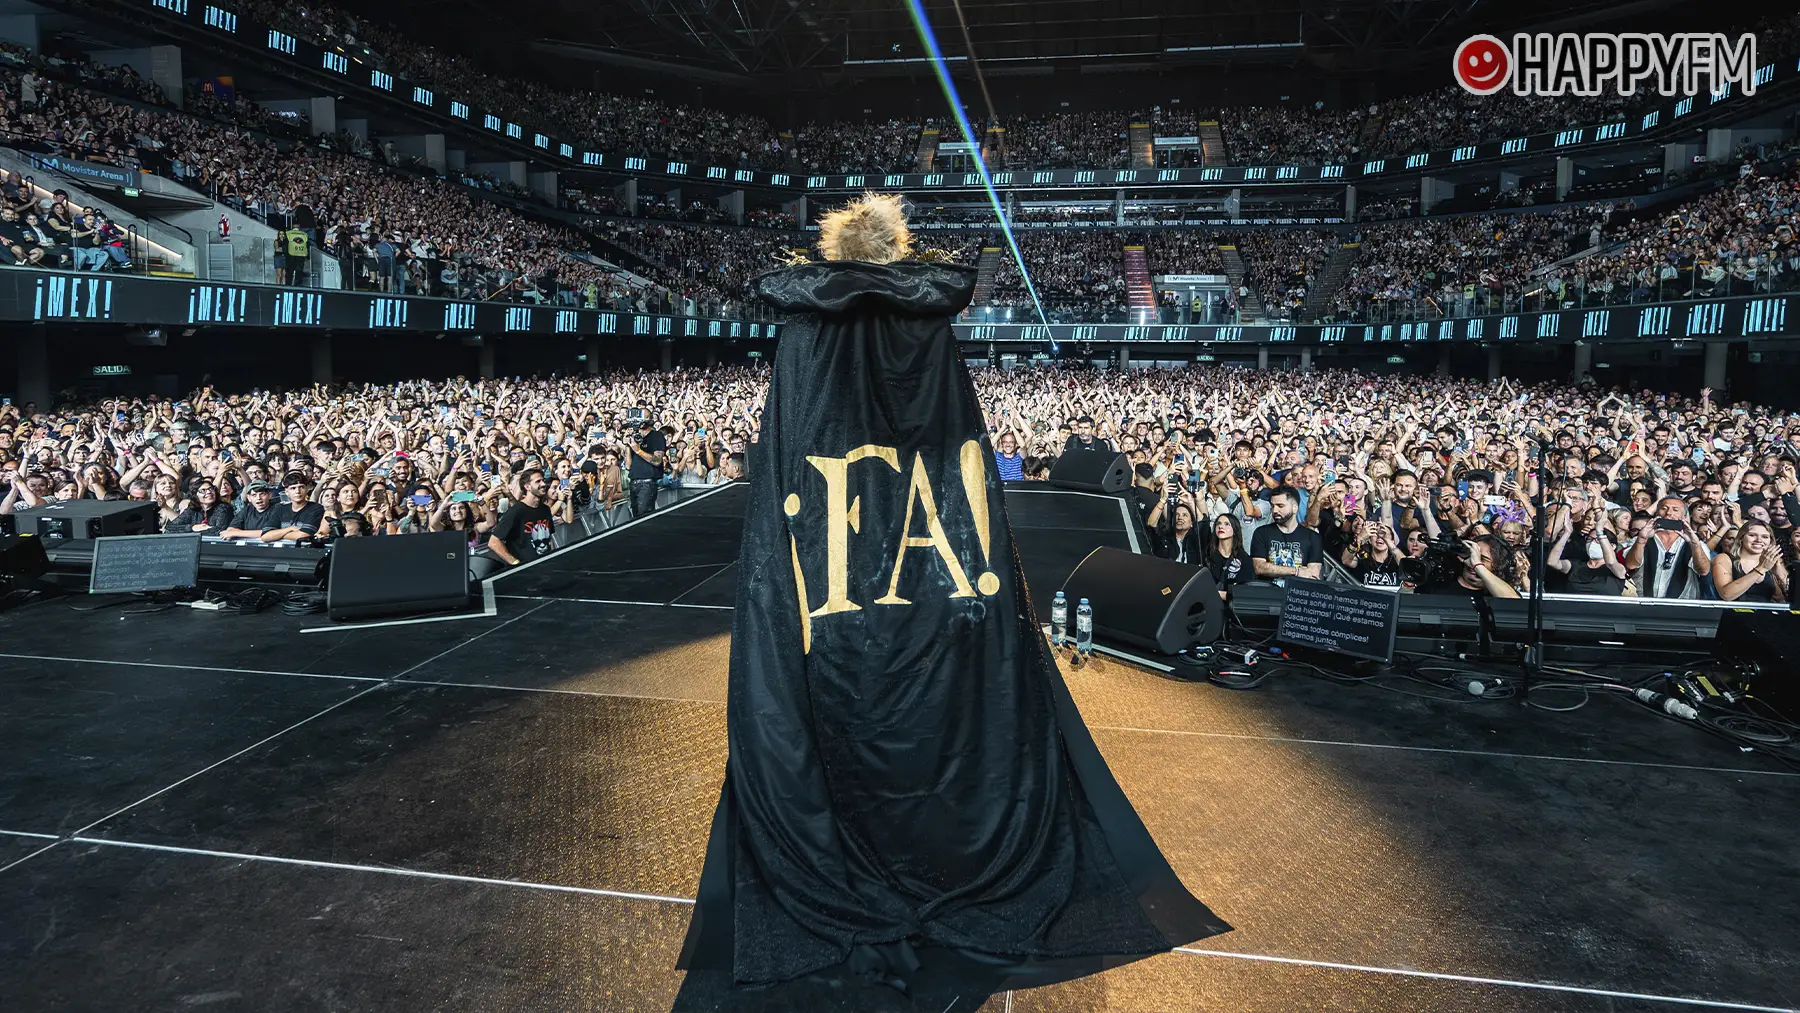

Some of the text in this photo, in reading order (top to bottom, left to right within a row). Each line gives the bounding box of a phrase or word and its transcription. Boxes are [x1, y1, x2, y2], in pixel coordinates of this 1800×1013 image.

[205, 6, 236, 33] ¡MEX!
[269, 30, 295, 55] ¡MEX!
[323, 52, 347, 75] ¡MEX!
[372, 70, 393, 91] ¡MEX!
[1555, 129, 1583, 147] ¡MEX!
[1596, 122, 1625, 141] ¡MEX!
[1452, 146, 1476, 162] ¡MEX!
[1501, 138, 1527, 155] ¡MEX!
[625, 158, 646, 171] ¡MEX!
[667, 162, 687, 175] ¡MEX!
[1364, 160, 1385, 175] ¡MEX!
[1406, 154, 1429, 169] ¡MEX!
[62, 163, 124, 181] Movistar Arena
[34, 276, 112, 319] ¡MEX!
[188, 286, 246, 323] ¡MEX!
[274, 292, 322, 326] ¡MEX!
[369, 298, 408, 329] ¡MEX!
[444, 303, 475, 330] ¡MEX!
[505, 308, 531, 332] ¡MEX!
[555, 311, 578, 333] ¡MEX!
[1537, 313, 1560, 338] ¡MEX!
[1582, 311, 1609, 337] ¡MEX!
[1638, 307, 1671, 337] ¡MEX!
[1686, 304, 1725, 336] ¡MEX!
[970, 326, 996, 339] ¡MEX!
[1021, 326, 1046, 339] ¡MEX!
[1072, 326, 1098, 340] ¡MEX!
[1124, 326, 1150, 340] ¡MEX!
[1162, 327, 1188, 340] ¡MEX!
[1215, 327, 1242, 341] ¡MEX!
[1269, 327, 1296, 341] ¡MEX!
[1320, 327, 1345, 341] ¡MEX!
[94, 365, 131, 374] SALIDA
[784, 439, 1000, 655] ¡FA!
[1363, 571, 1397, 586] ¡FA!
[1286, 595, 1308, 605] Nunca
[1366, 610, 1384, 619] esto.
[1287, 588, 1309, 597] ¡Hasta
[1334, 595, 1358, 605] hemos
[1360, 598, 1389, 610] llegado!
[1284, 612, 1319, 624] buscando!
[1352, 616, 1384, 628] estamos
[1282, 620, 1309, 631] ¡Somos
[1310, 625, 1329, 635] todos
[1281, 628, 1339, 647] Llegamos juntos.
